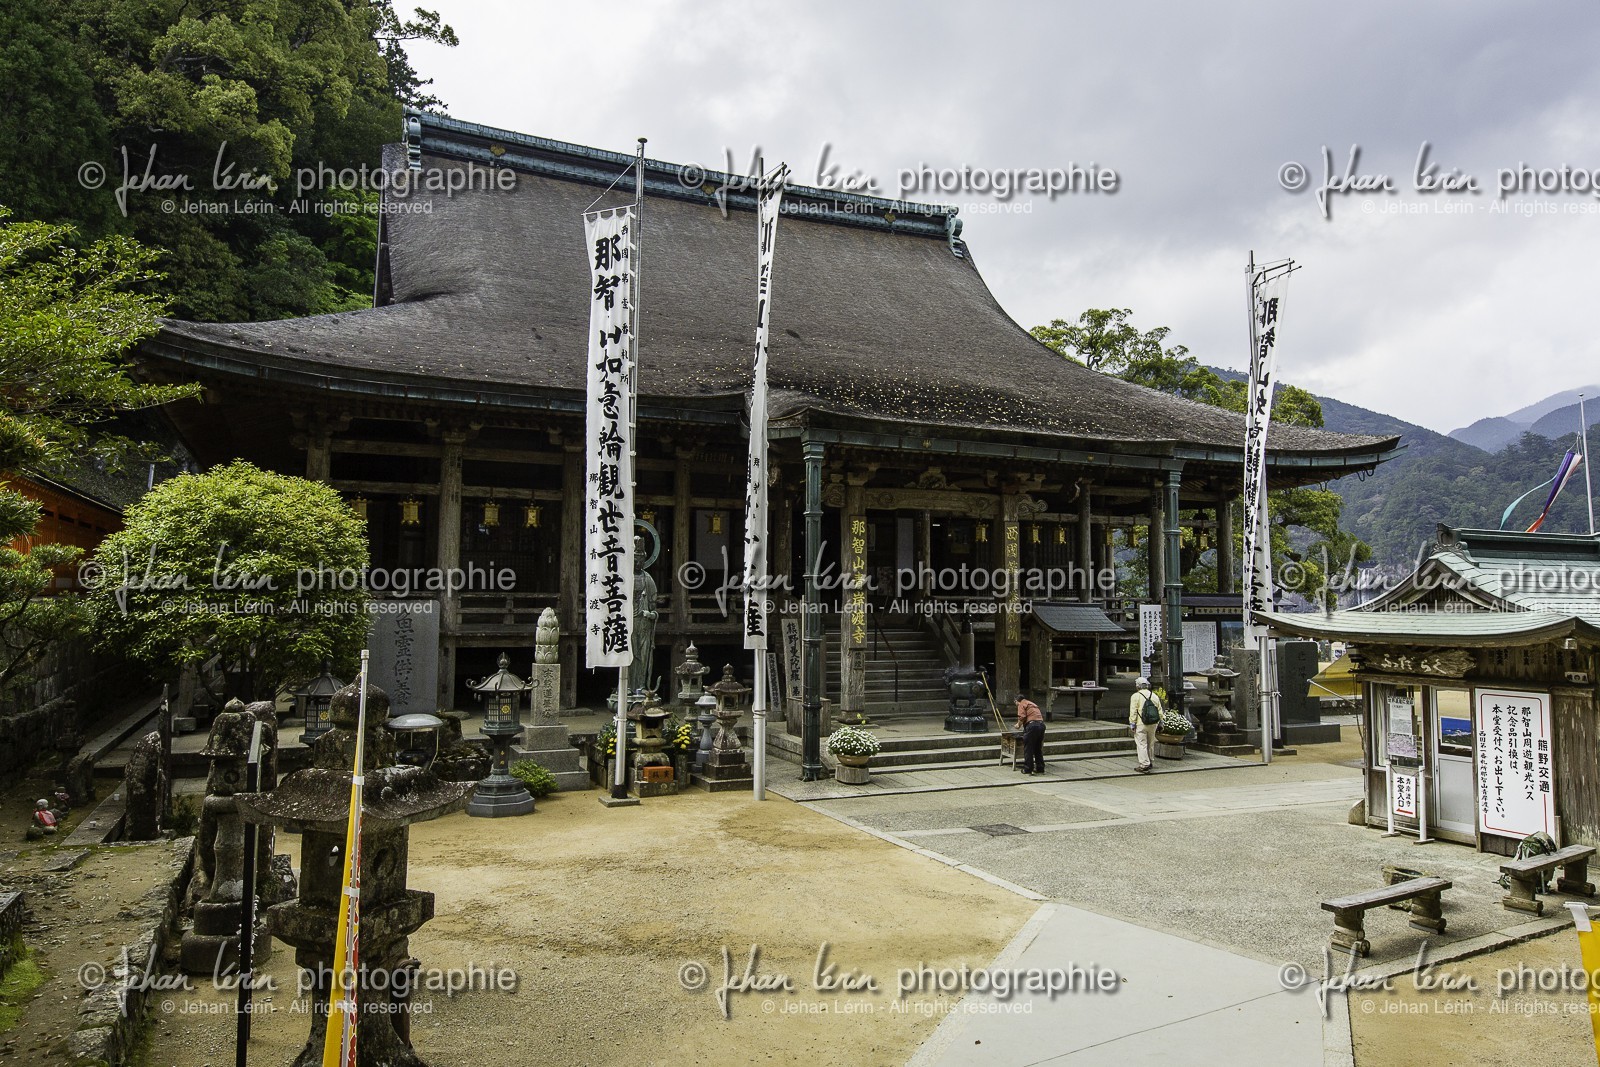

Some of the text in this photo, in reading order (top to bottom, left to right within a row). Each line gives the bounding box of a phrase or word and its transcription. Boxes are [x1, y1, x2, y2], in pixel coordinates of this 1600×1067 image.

[589, 472, 600, 636] 那智山青岸渡寺
[1521, 707, 1534, 800] 那智山周遊観光バス
[1537, 739, 1550, 793] 熊野交通
[1396, 776, 1405, 808] 本堂入口
